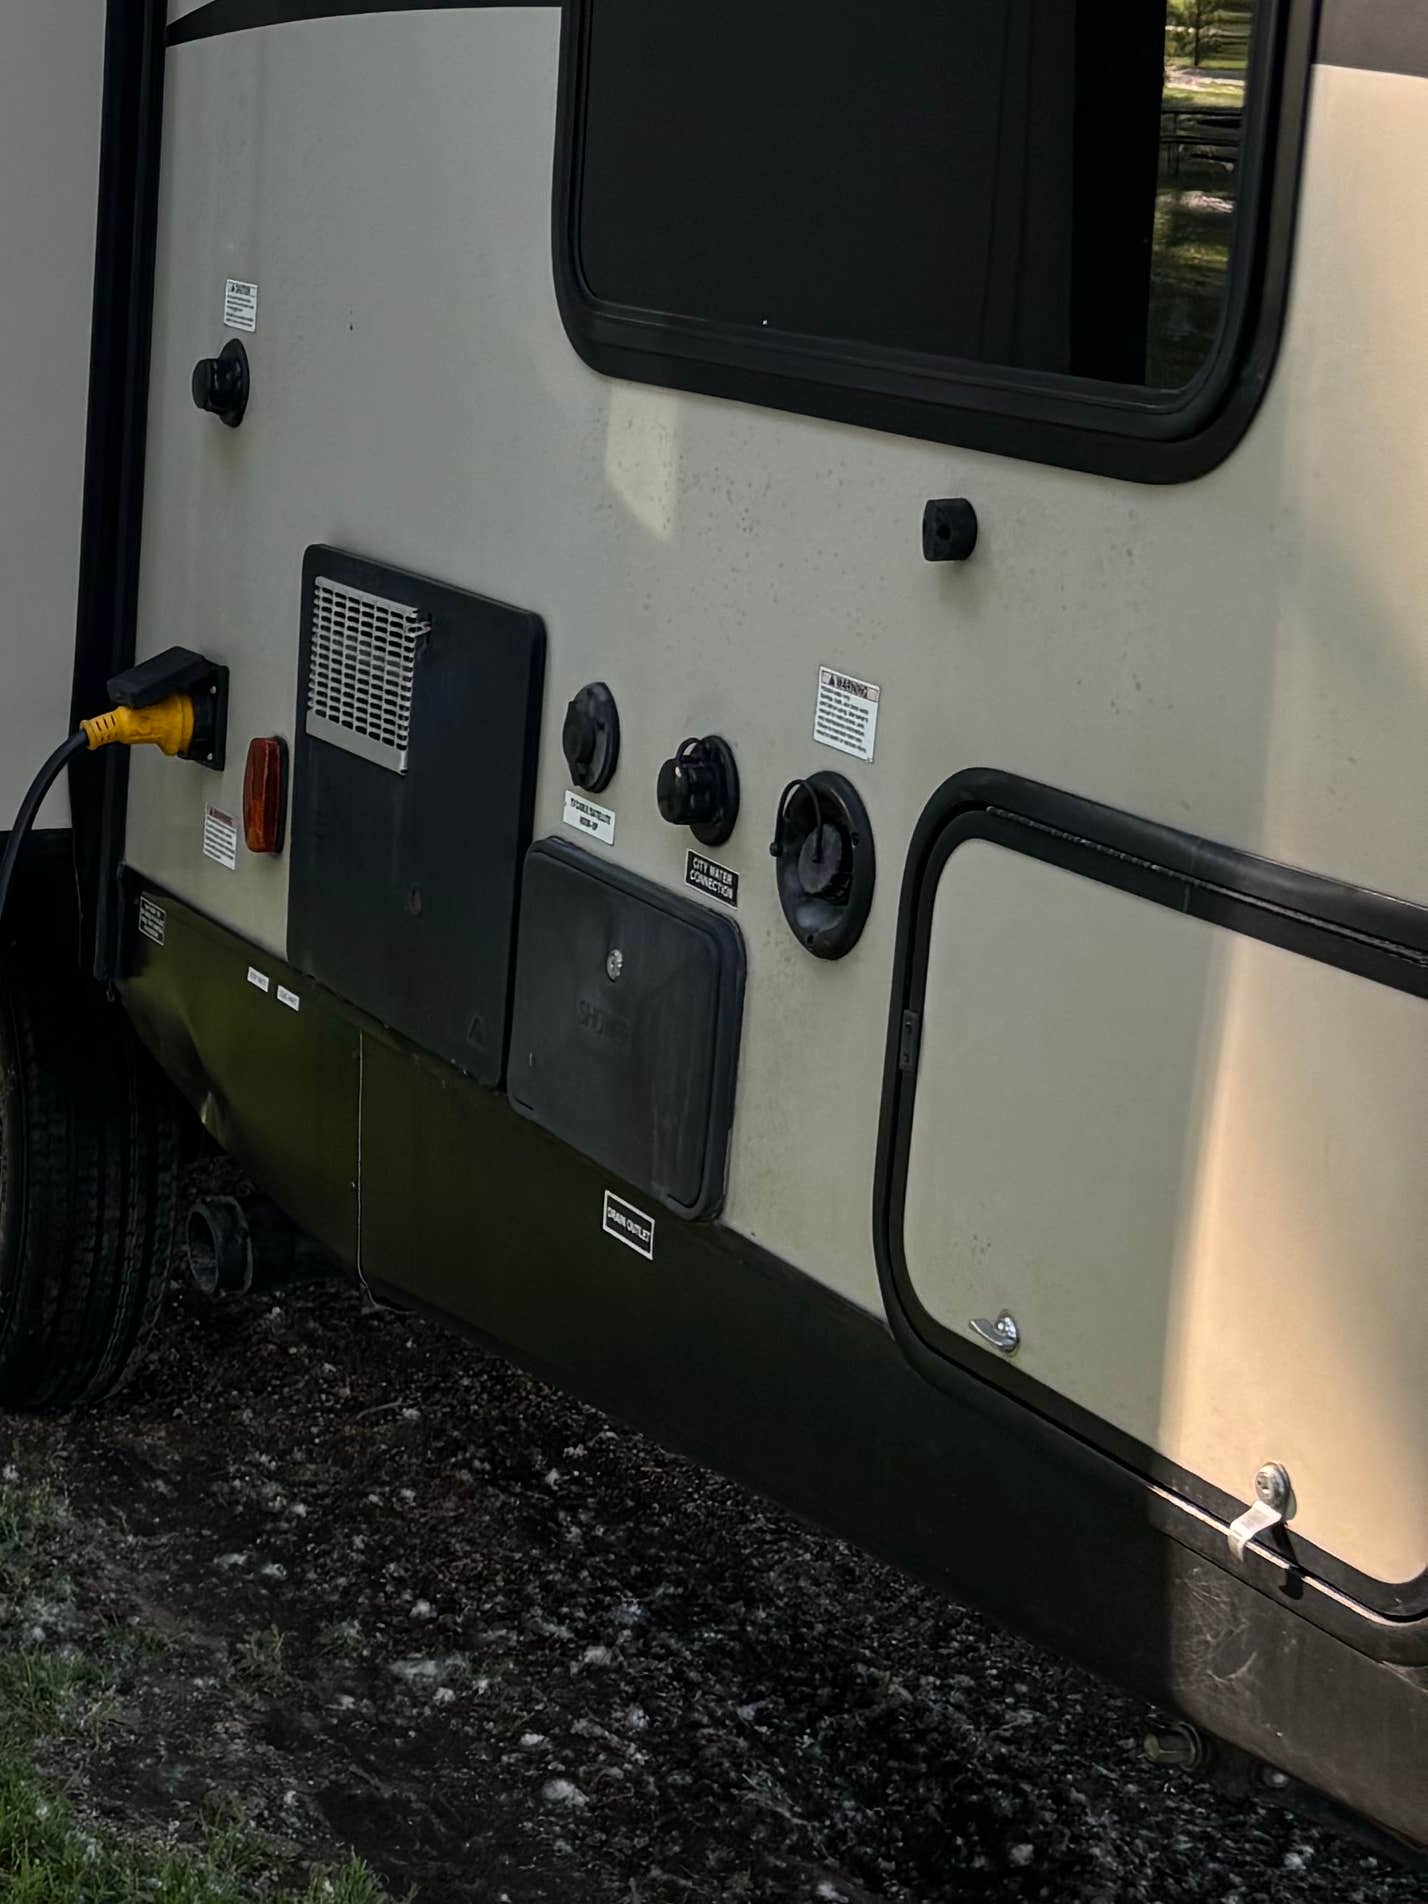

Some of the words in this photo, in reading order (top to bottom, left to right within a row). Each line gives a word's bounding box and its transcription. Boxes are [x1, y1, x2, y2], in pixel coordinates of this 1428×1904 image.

[690, 870, 733, 899] CONNECTION
[693, 857, 708, 874] CITY
[709, 865, 732, 886] WATER
[627, 1219, 651, 1243] OUTLET
